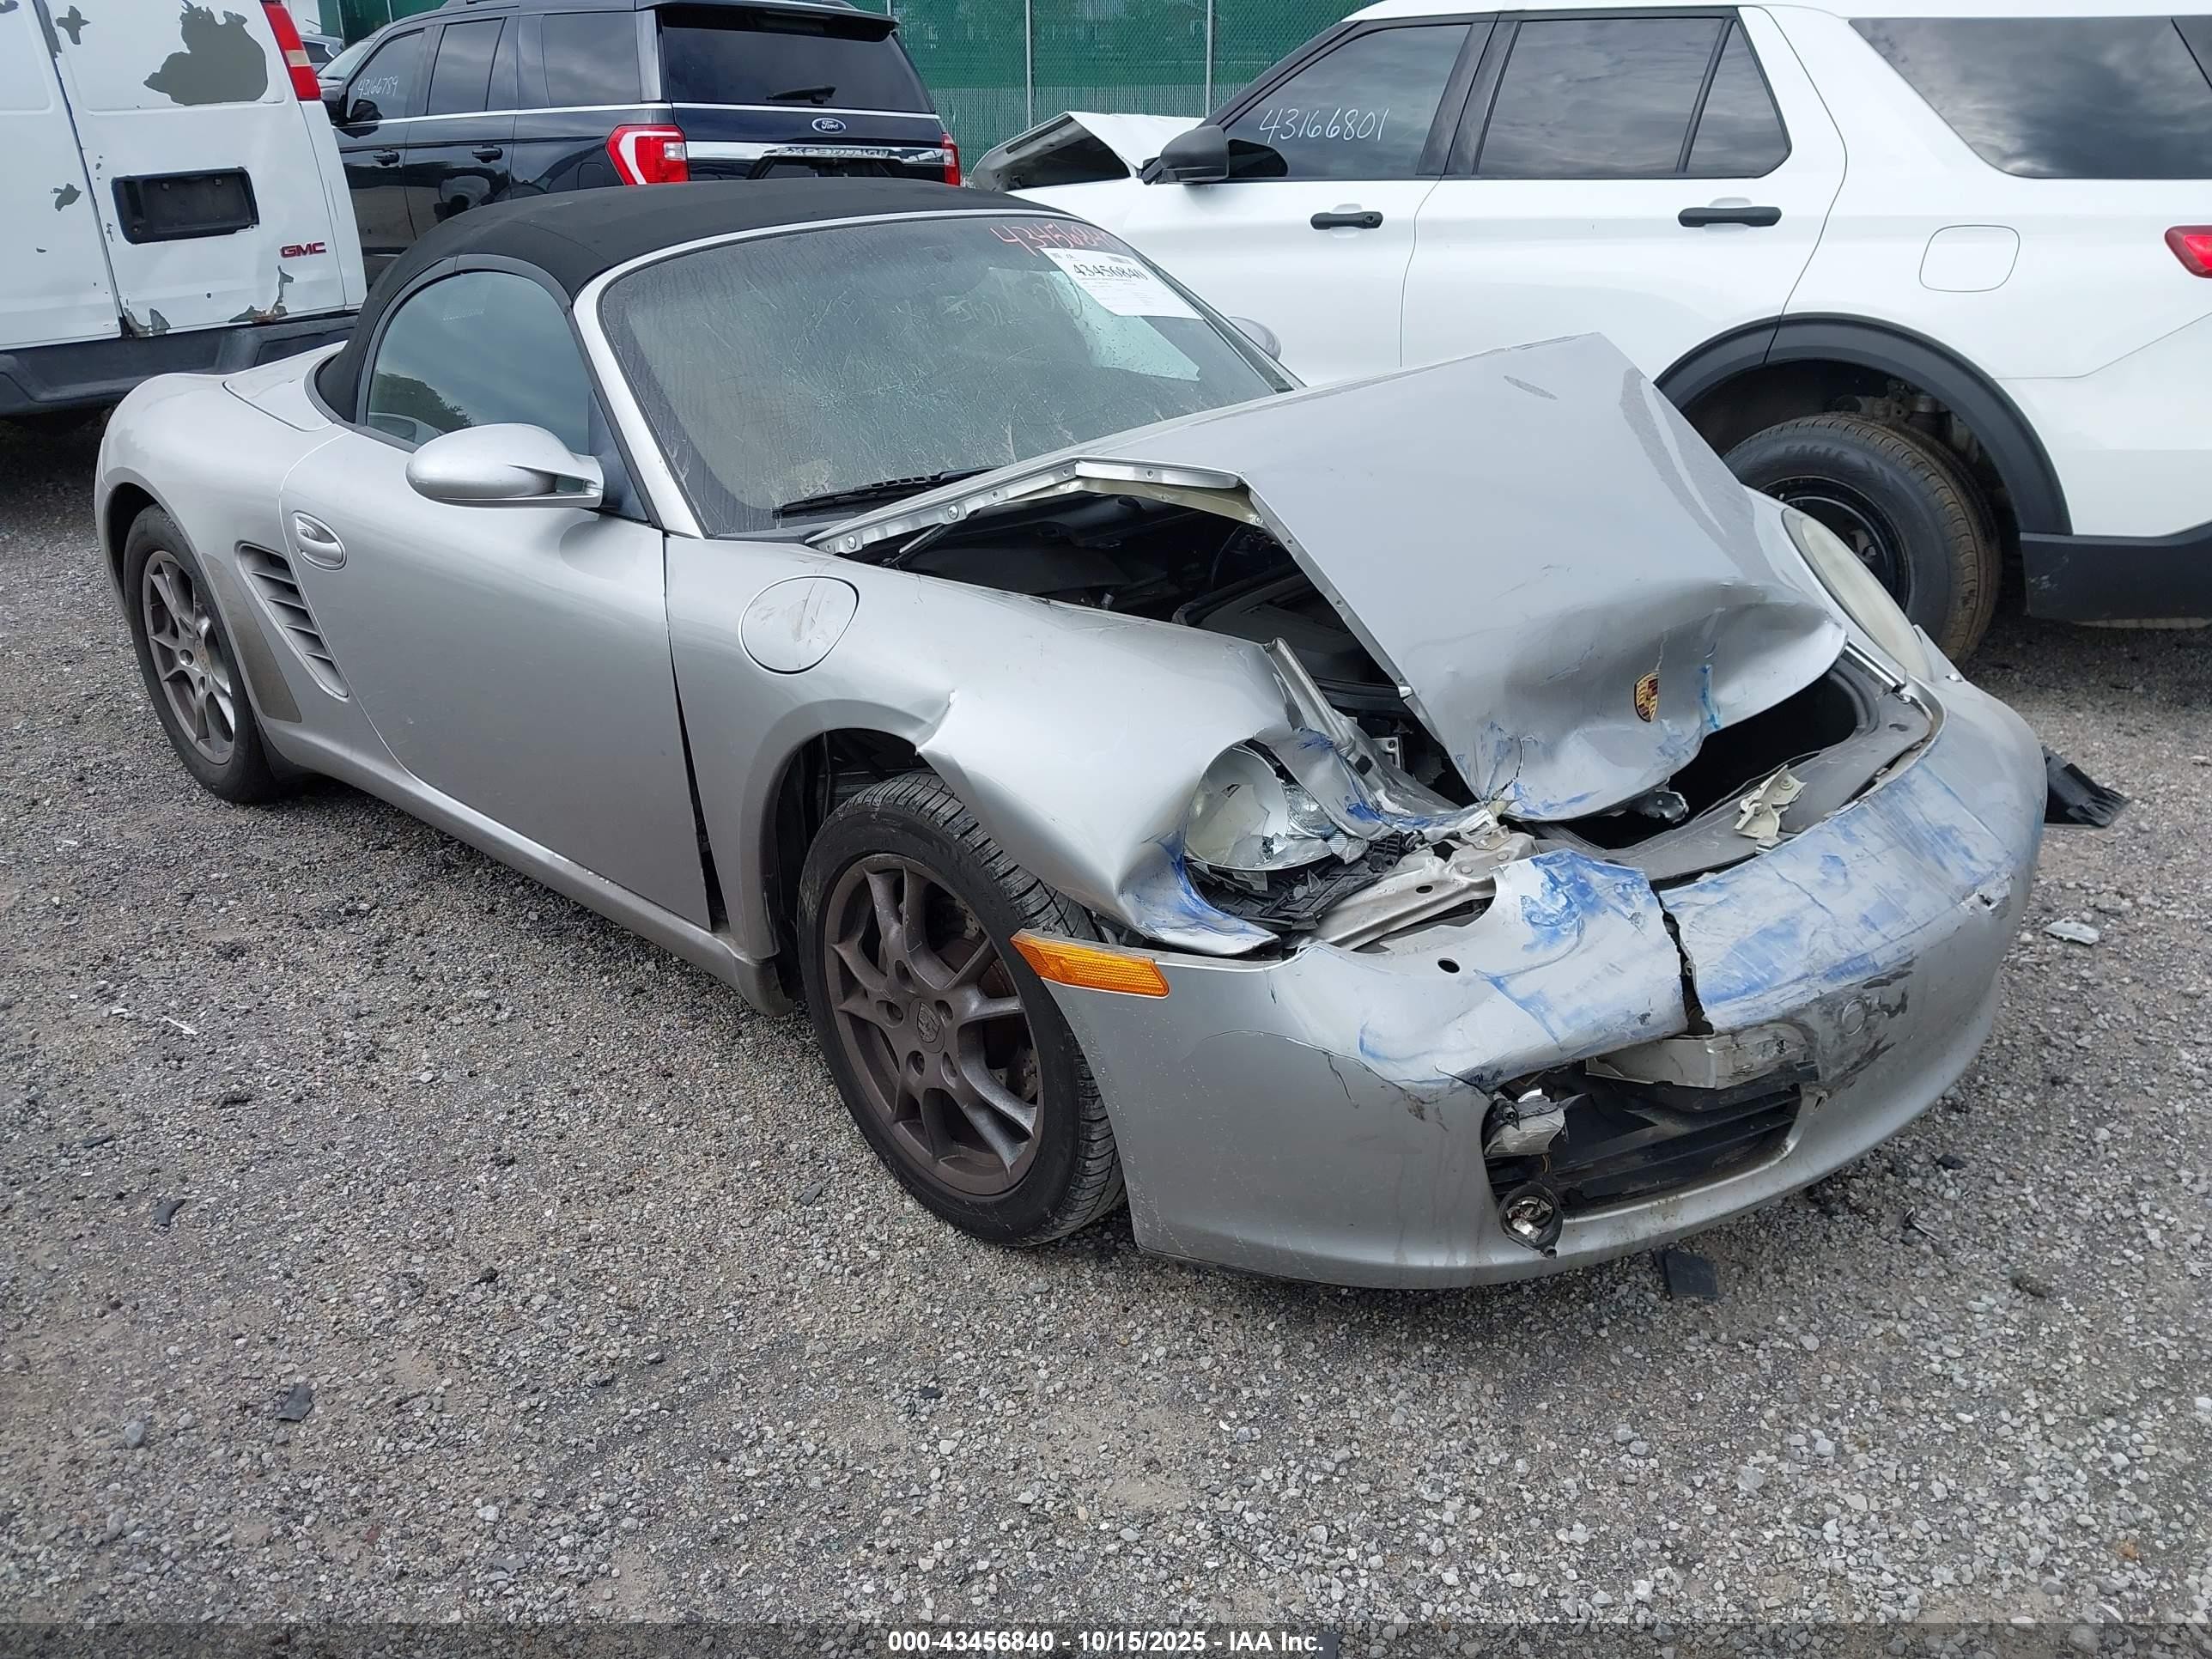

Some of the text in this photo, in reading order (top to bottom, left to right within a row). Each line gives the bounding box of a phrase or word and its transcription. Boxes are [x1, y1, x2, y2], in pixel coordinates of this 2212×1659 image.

[1259, 107, 1389, 144] 43166801
[776, 147, 889, 158] EXPEDITION
[280, 241, 327, 258] GMC
[1073, 264, 1148, 281] 43456840
